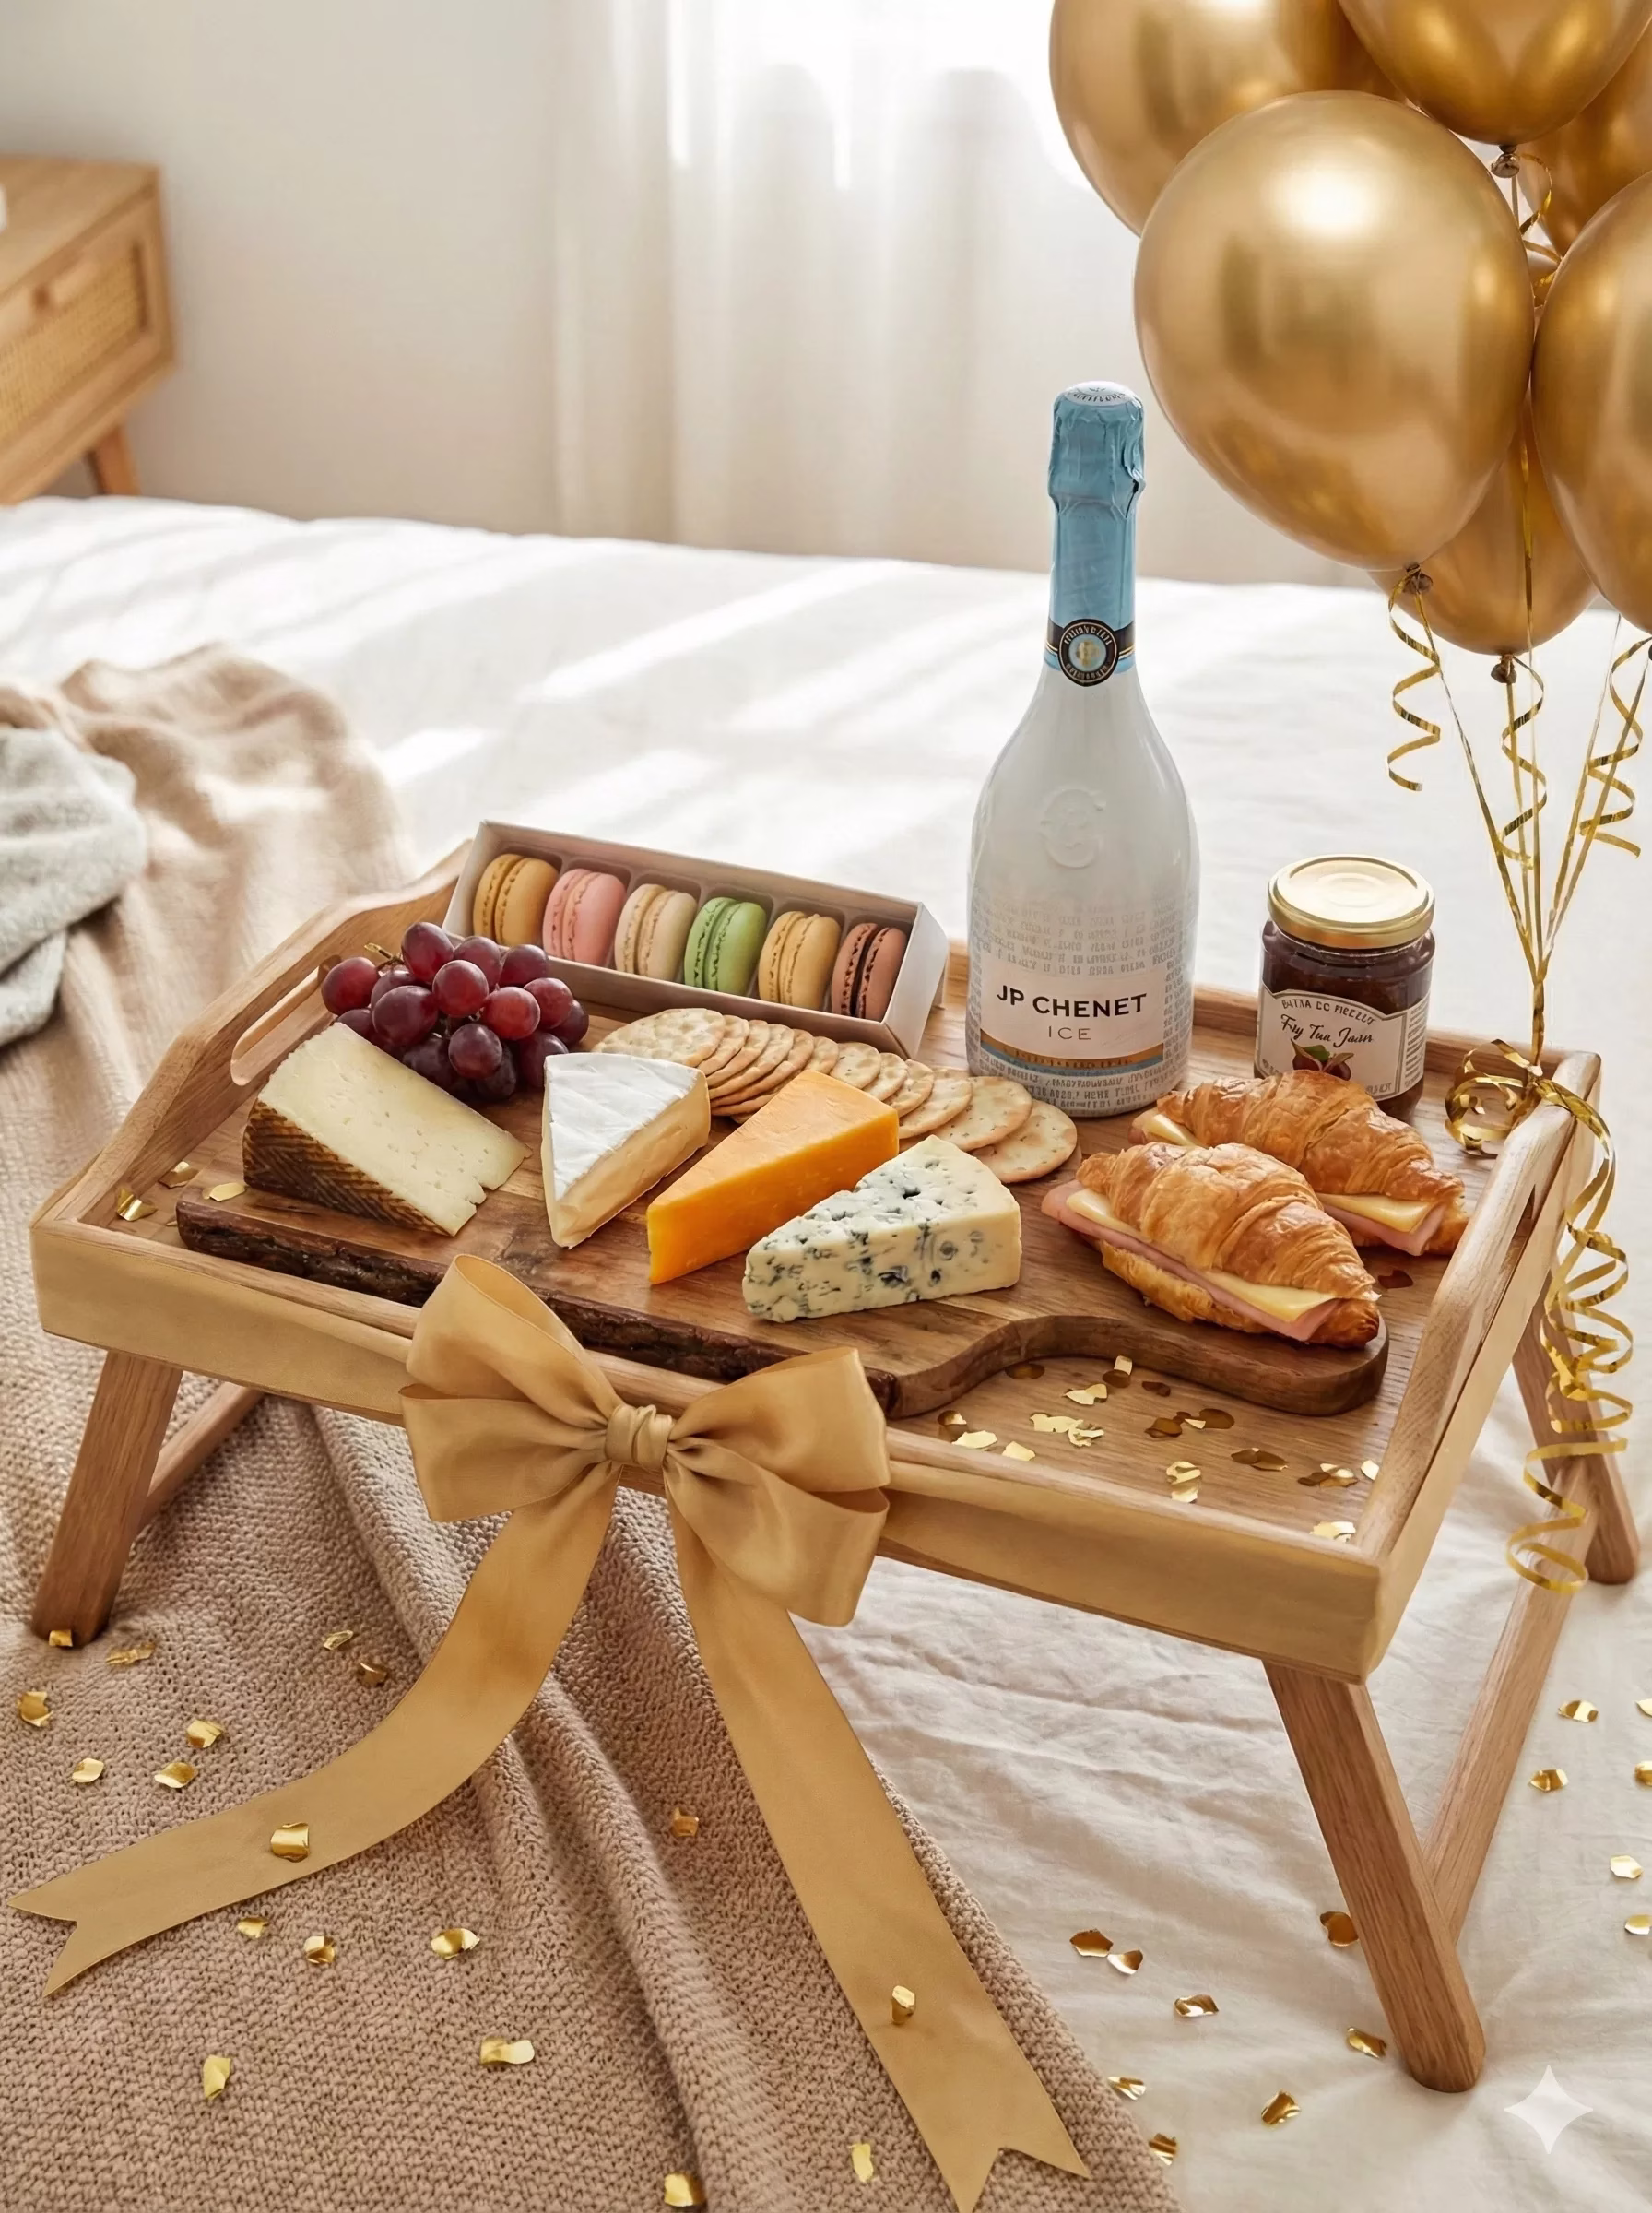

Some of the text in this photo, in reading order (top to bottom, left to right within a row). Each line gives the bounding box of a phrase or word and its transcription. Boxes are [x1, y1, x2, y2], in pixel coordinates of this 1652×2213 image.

[997, 985, 1147, 1018] JP CHENET
[1048, 1025, 1092, 1040] ICE
